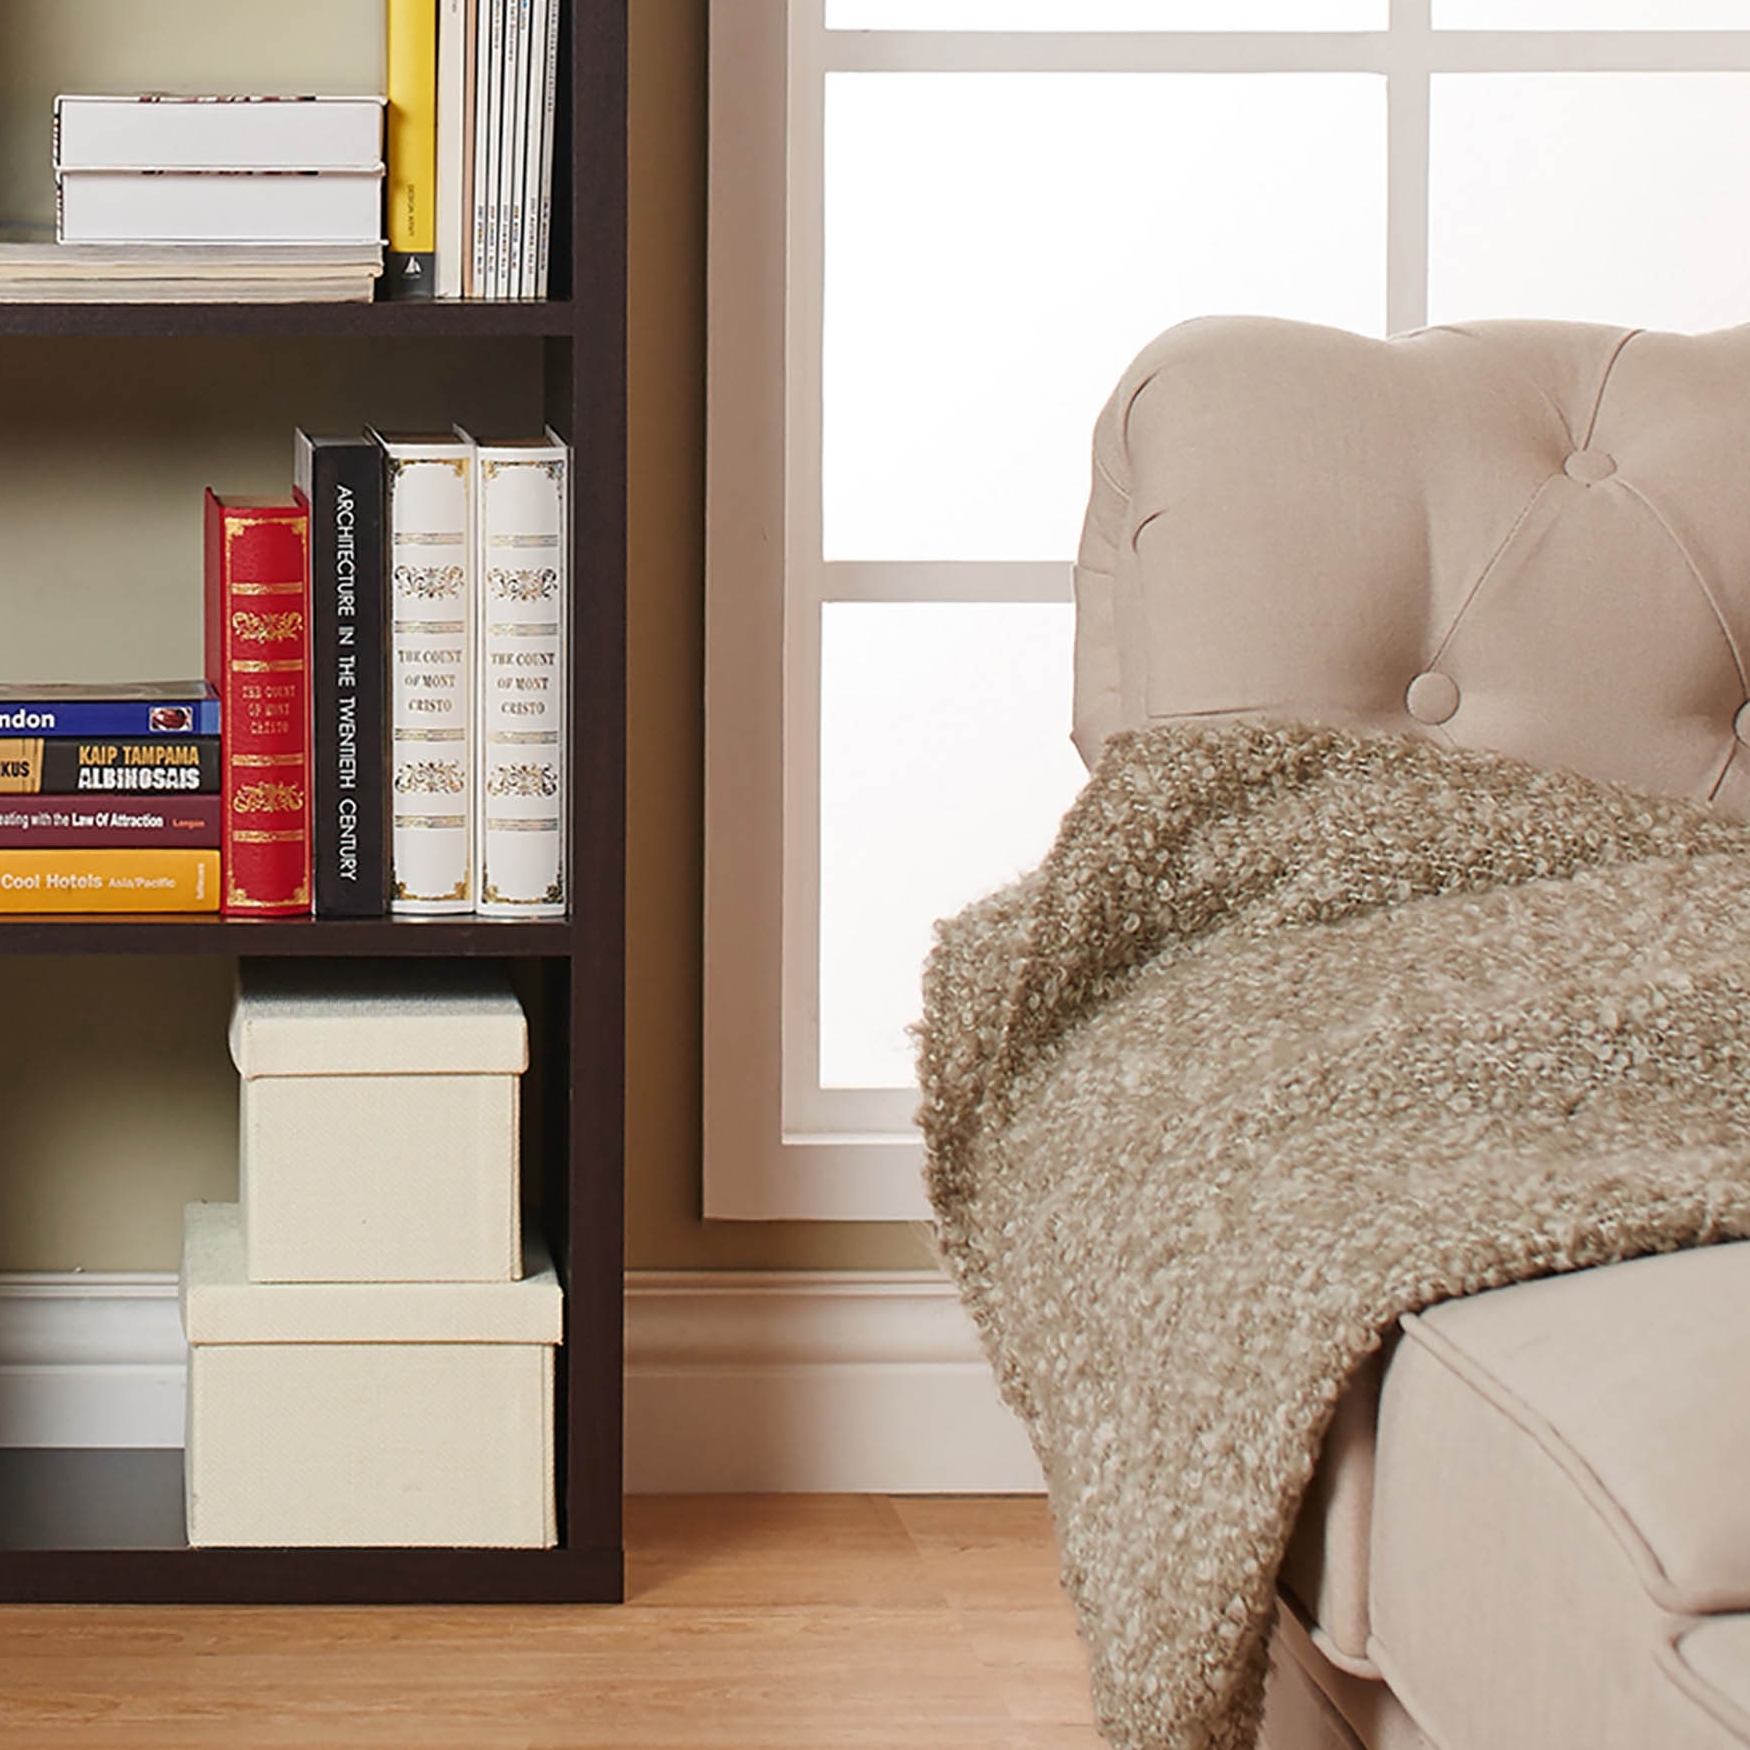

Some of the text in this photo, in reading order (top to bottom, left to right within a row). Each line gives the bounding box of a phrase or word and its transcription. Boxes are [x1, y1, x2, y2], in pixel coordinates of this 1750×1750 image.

[398, 650, 422, 663] THE
[492, 653, 514, 666] THE
[337, 484, 358, 882] ARCHITECTURE IN THE TWENTIETH CENTURY
[408, 699, 452, 713] CRISTO
[501, 701, 545, 715] CRISTO
[79, 745, 200, 765] KAIP TAMPAMA
[31, 812, 52, 826] with
[53, 813, 70, 827] the
[72, 813, 95, 827] Law
[111, 812, 164, 828] Attraction
[1, 873, 176, 889] Cool Hotels Asia/Pacific
